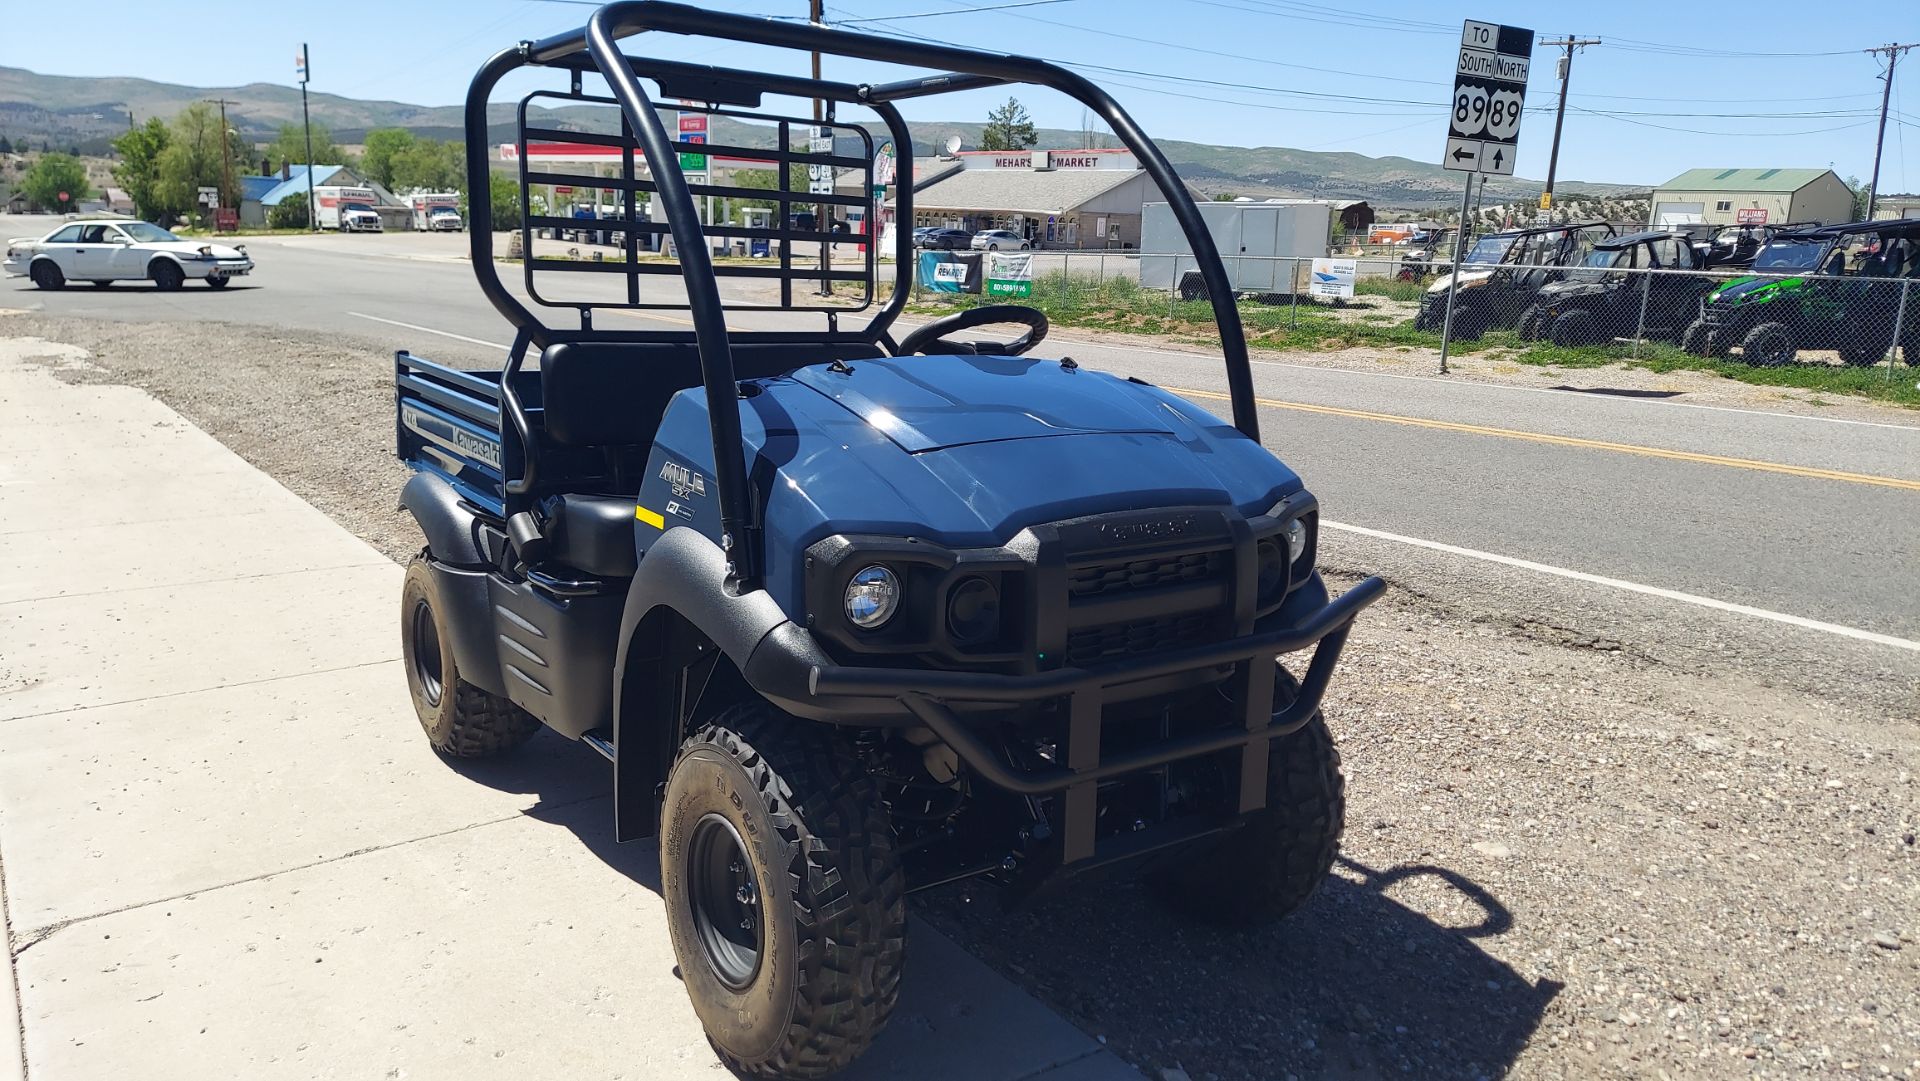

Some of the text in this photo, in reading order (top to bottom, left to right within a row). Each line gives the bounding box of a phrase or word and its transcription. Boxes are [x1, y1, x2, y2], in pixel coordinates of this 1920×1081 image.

[1473, 26, 1490, 43] TO
[1460, 52, 1493, 74] SOUTH
[1496, 57, 1528, 79] NORTH
[1455, 93, 1486, 124] 89
[1490, 99, 1520, 128] 89
[995, 157, 1099, 168] MEHAR'S MARKET
[1739, 209, 1767, 219] WILLIAMS
[452, 425, 500, 465] Kawasaki
[659, 461, 706, 497] MULE
[671, 483, 690, 501] SX
[668, 503, 678, 511] FI
[730, 788, 776, 899] DURO
